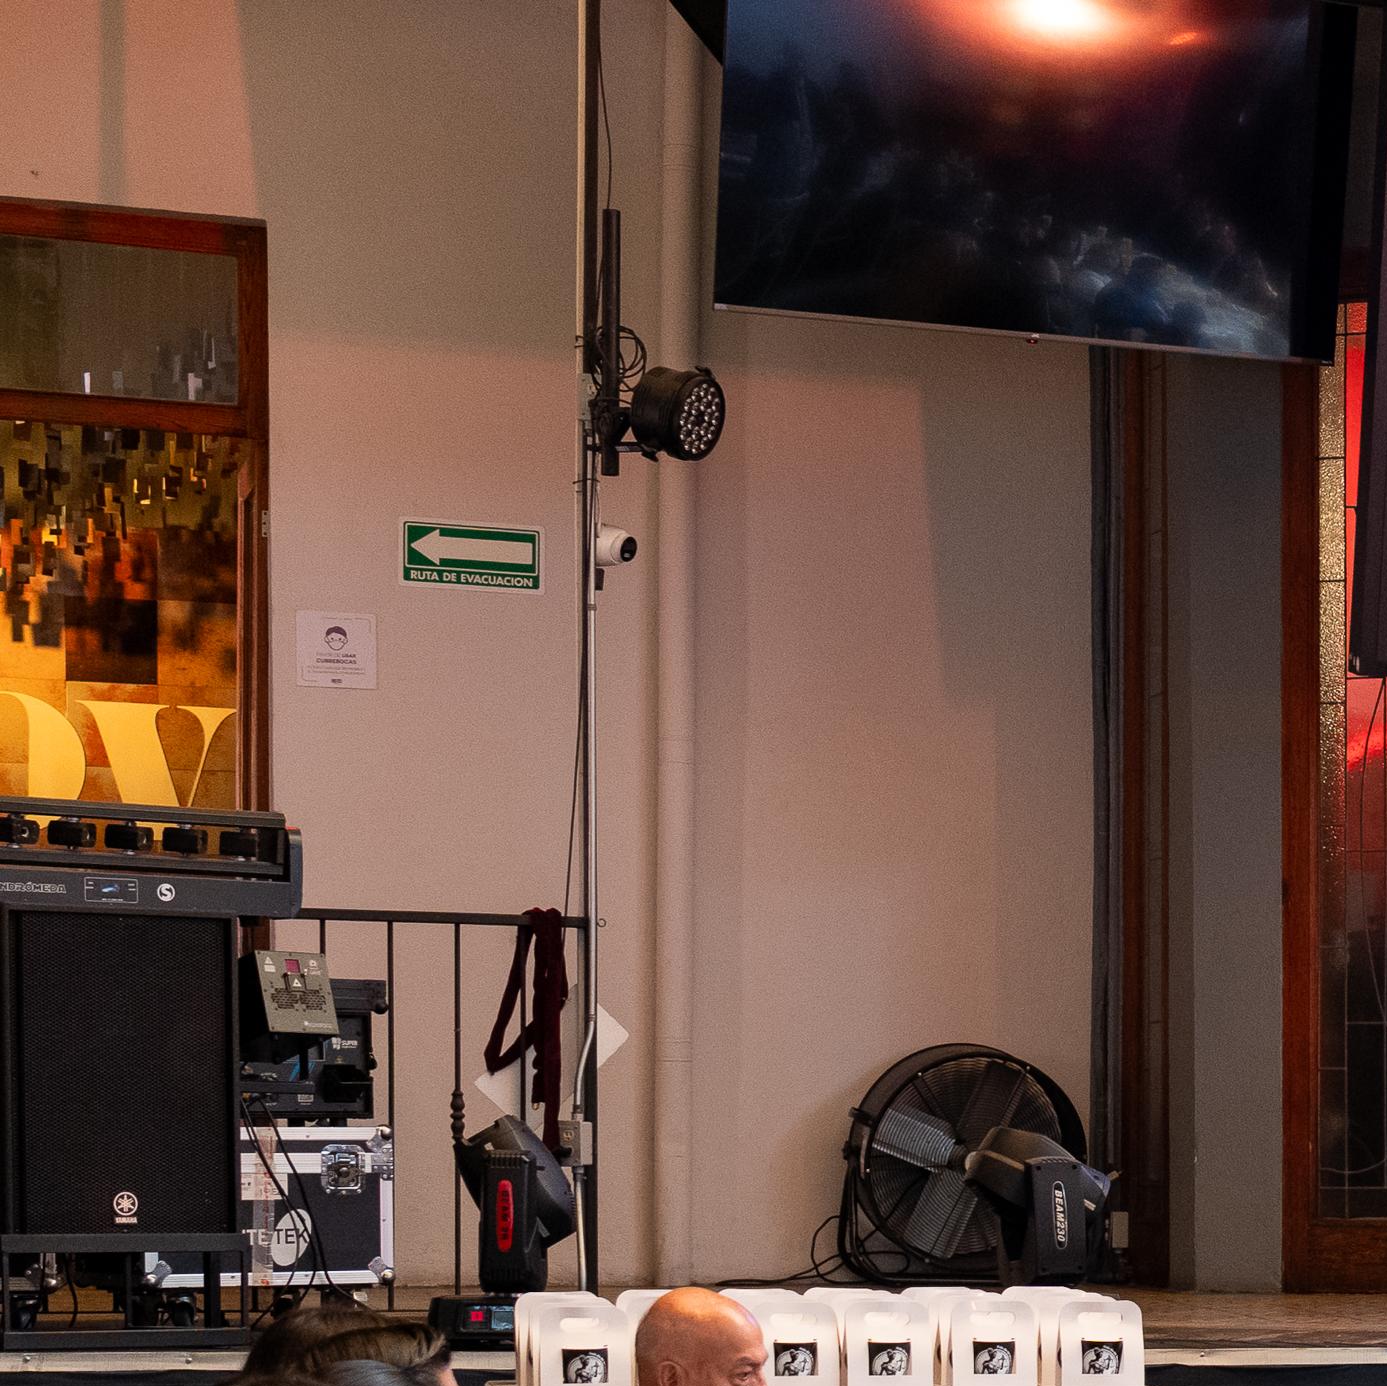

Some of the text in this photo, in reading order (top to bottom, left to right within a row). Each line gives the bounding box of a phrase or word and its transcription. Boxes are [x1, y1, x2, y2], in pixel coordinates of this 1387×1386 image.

[409, 569, 534, 588] RUTA DE EVACUACION
[1054, 1189, 1066, 1242] BEAM230
